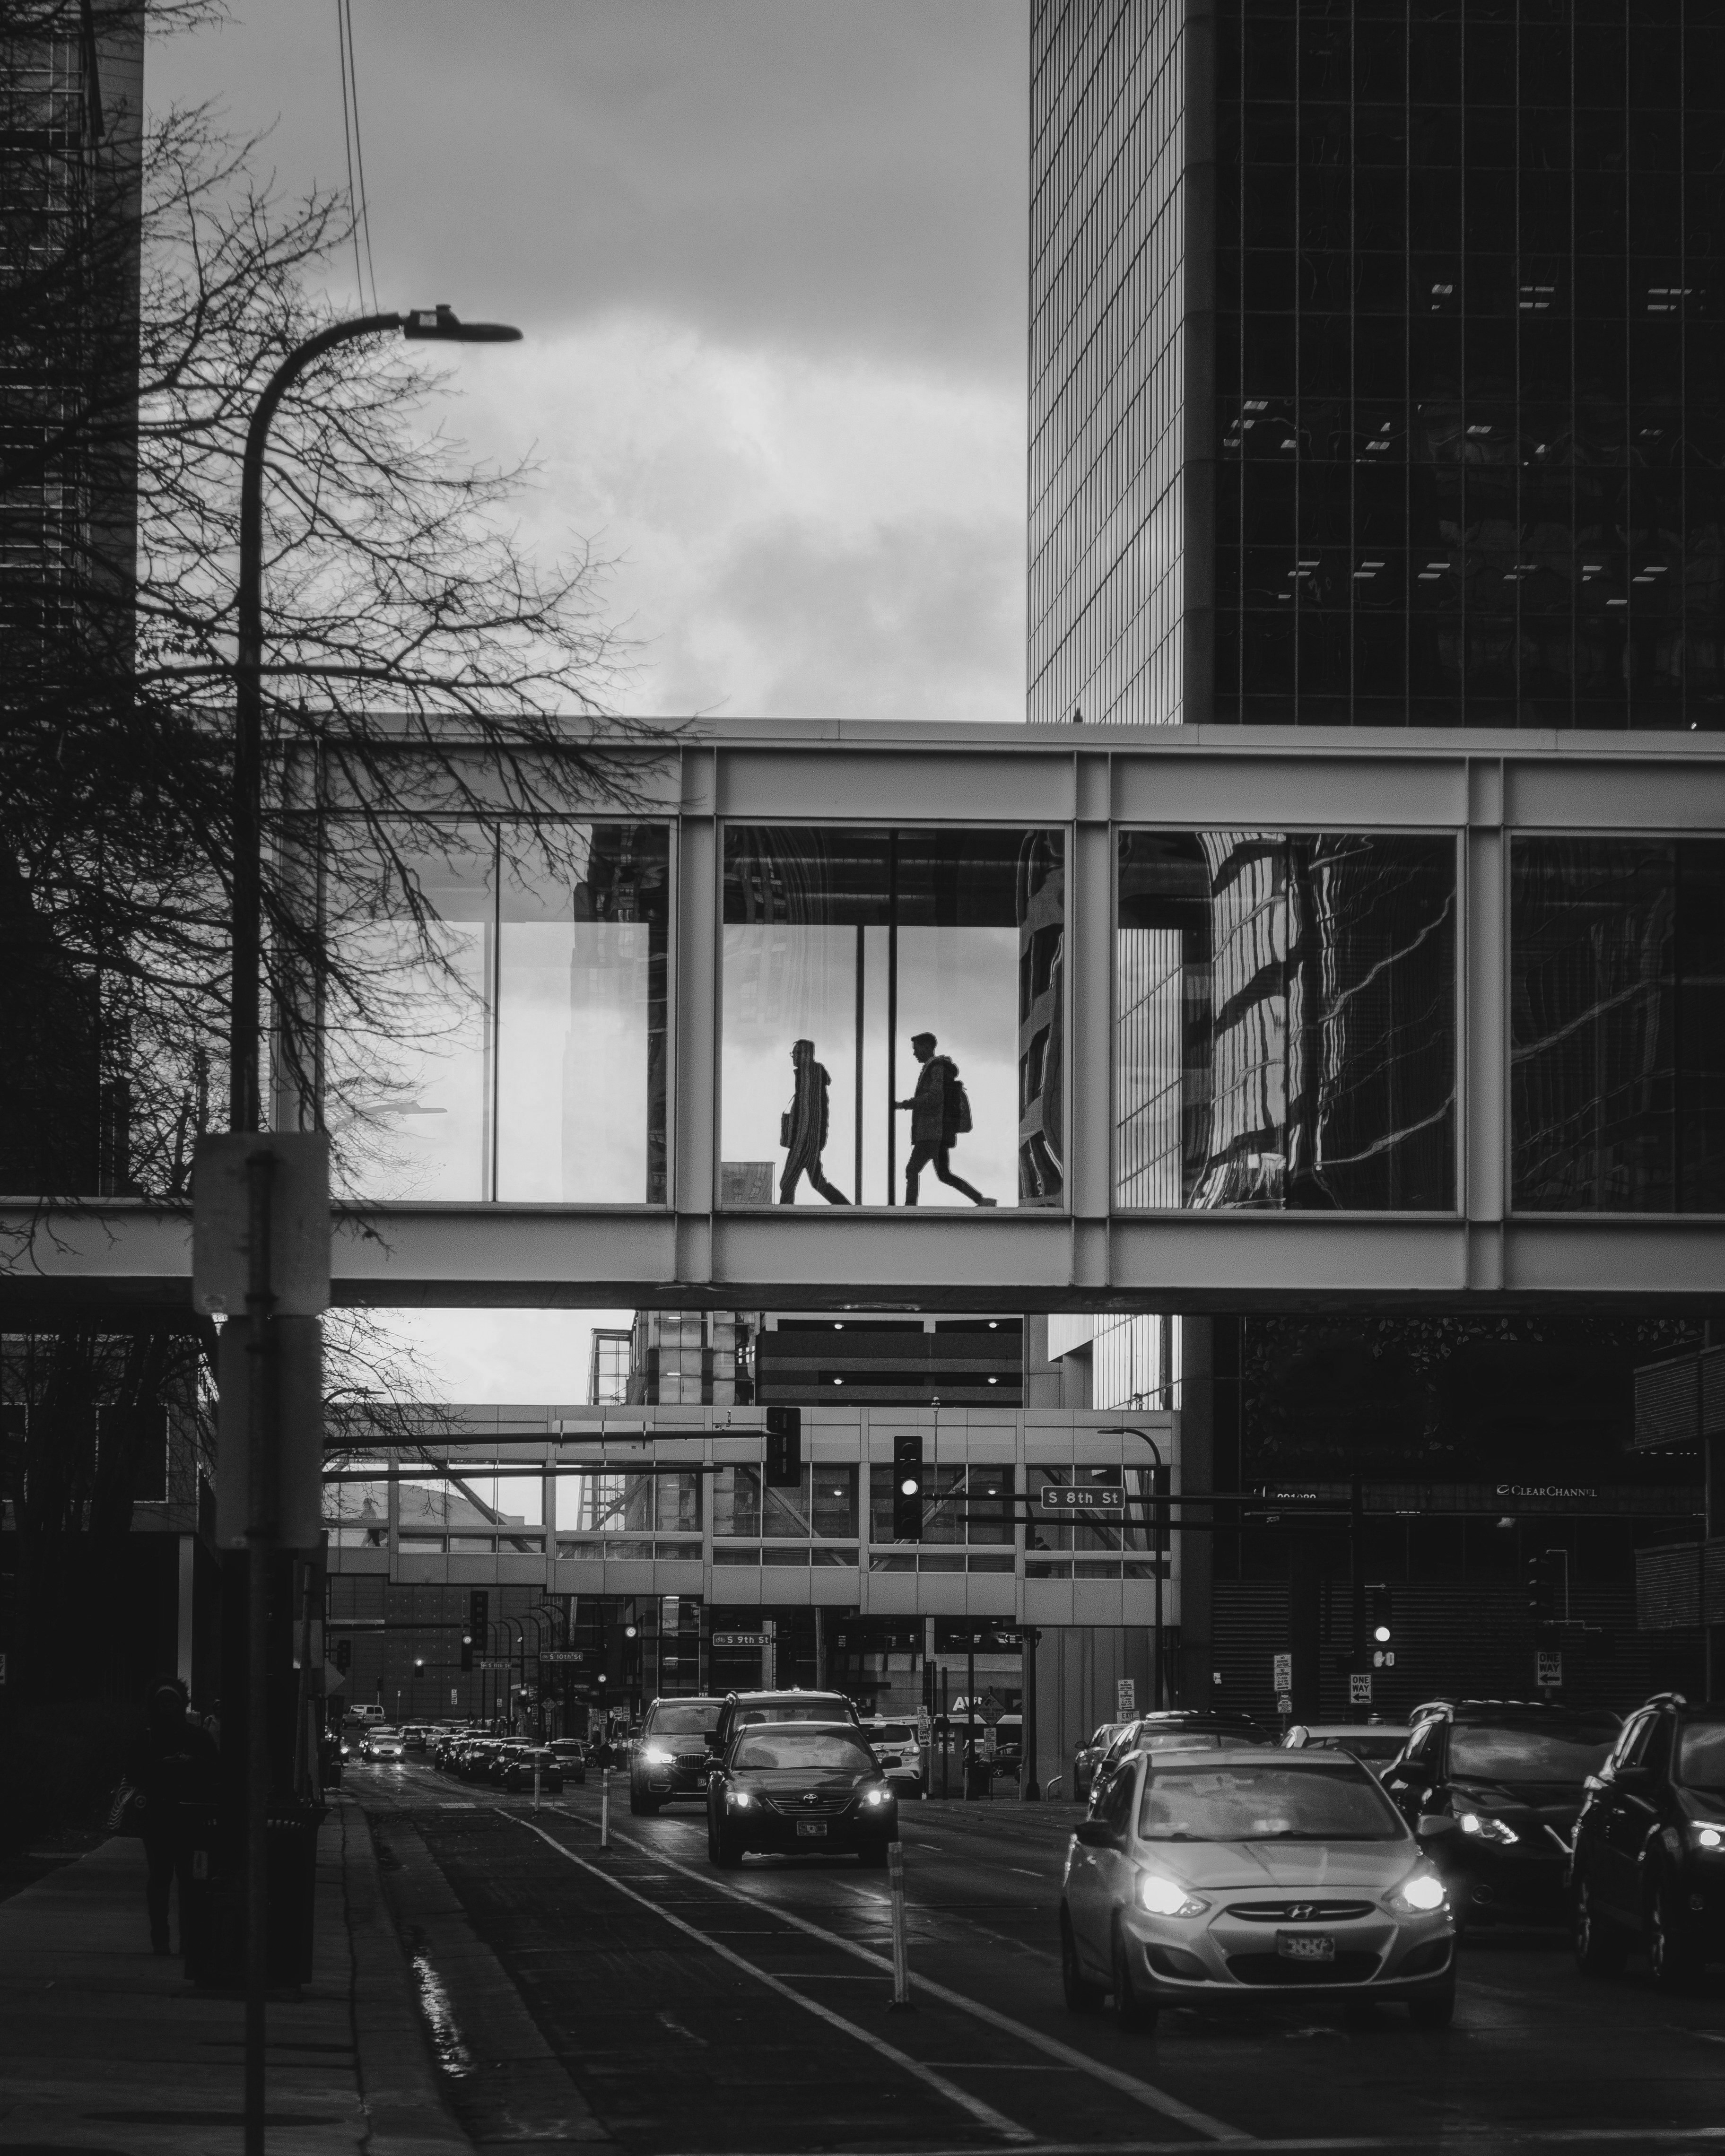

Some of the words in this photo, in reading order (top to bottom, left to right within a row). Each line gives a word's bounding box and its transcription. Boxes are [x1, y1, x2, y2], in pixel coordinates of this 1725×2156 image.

[1049, 1492, 1057, 1503] S
[1067, 1492, 1093, 1504] 8th
[1102, 1493, 1118, 1504] St
[1540, 1653, 1560, 1662] ONE
[1540, 1664, 1560, 1672] WAY
